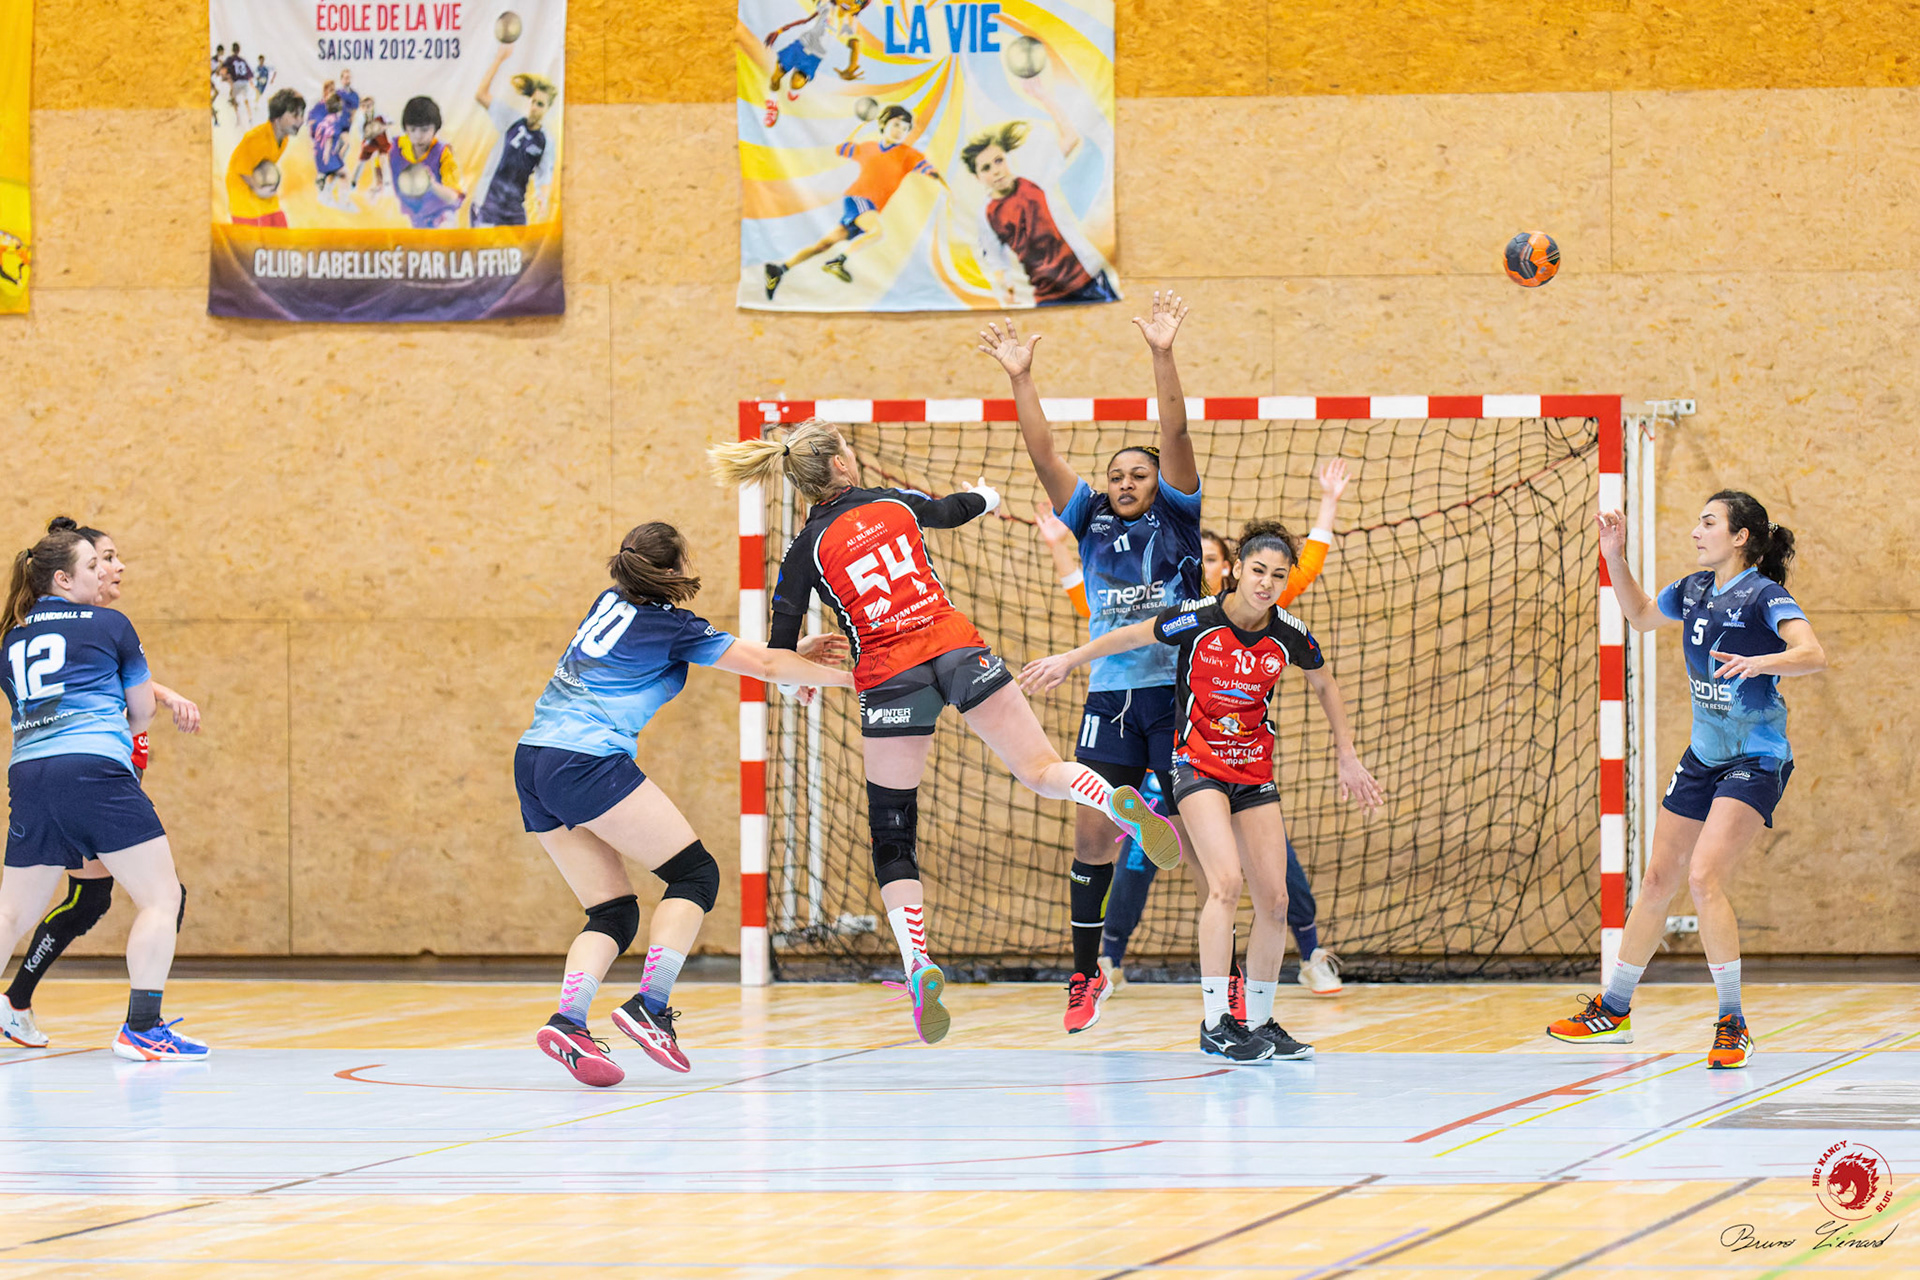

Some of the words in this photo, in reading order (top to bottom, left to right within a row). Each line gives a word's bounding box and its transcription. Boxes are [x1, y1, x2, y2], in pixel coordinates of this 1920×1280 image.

[376, 3, 400, 32] DE
[404, 3, 428, 31] LA
[432, 2, 462, 31] VIE
[885, 3, 931, 54] LA
[944, 3, 1001, 53] VIE
[317, 38, 374, 61] SAISON
[379, 37, 461, 60] 2012-2013
[253, 248, 304, 278] CLUB
[306, 245, 404, 280] LABELLISÉ
[407, 250, 446, 279] PAR
[450, 250, 475, 279] LA
[477, 247, 523, 278] FFHB
[846, 537, 857, 548] AU
[856, 521, 885, 542] BUREAU
[1113, 532, 1131, 553] 11
[844, 533, 921, 597] 54
[33, 610, 79, 623] HANDBALL
[570, 591, 639, 659] 10
[1690, 617, 1709, 646] 5
[8, 632, 67, 701] 12
[1230, 648, 1257, 675] 10
[1211, 676, 1230, 690] Guy
[1230, 679, 1262, 692] Hoquet
[1688, 675, 1733, 702] nedis
[881, 716, 911, 724] SPORT
[883, 707, 911, 717] INTER
[1080, 713, 1100, 749] 11
